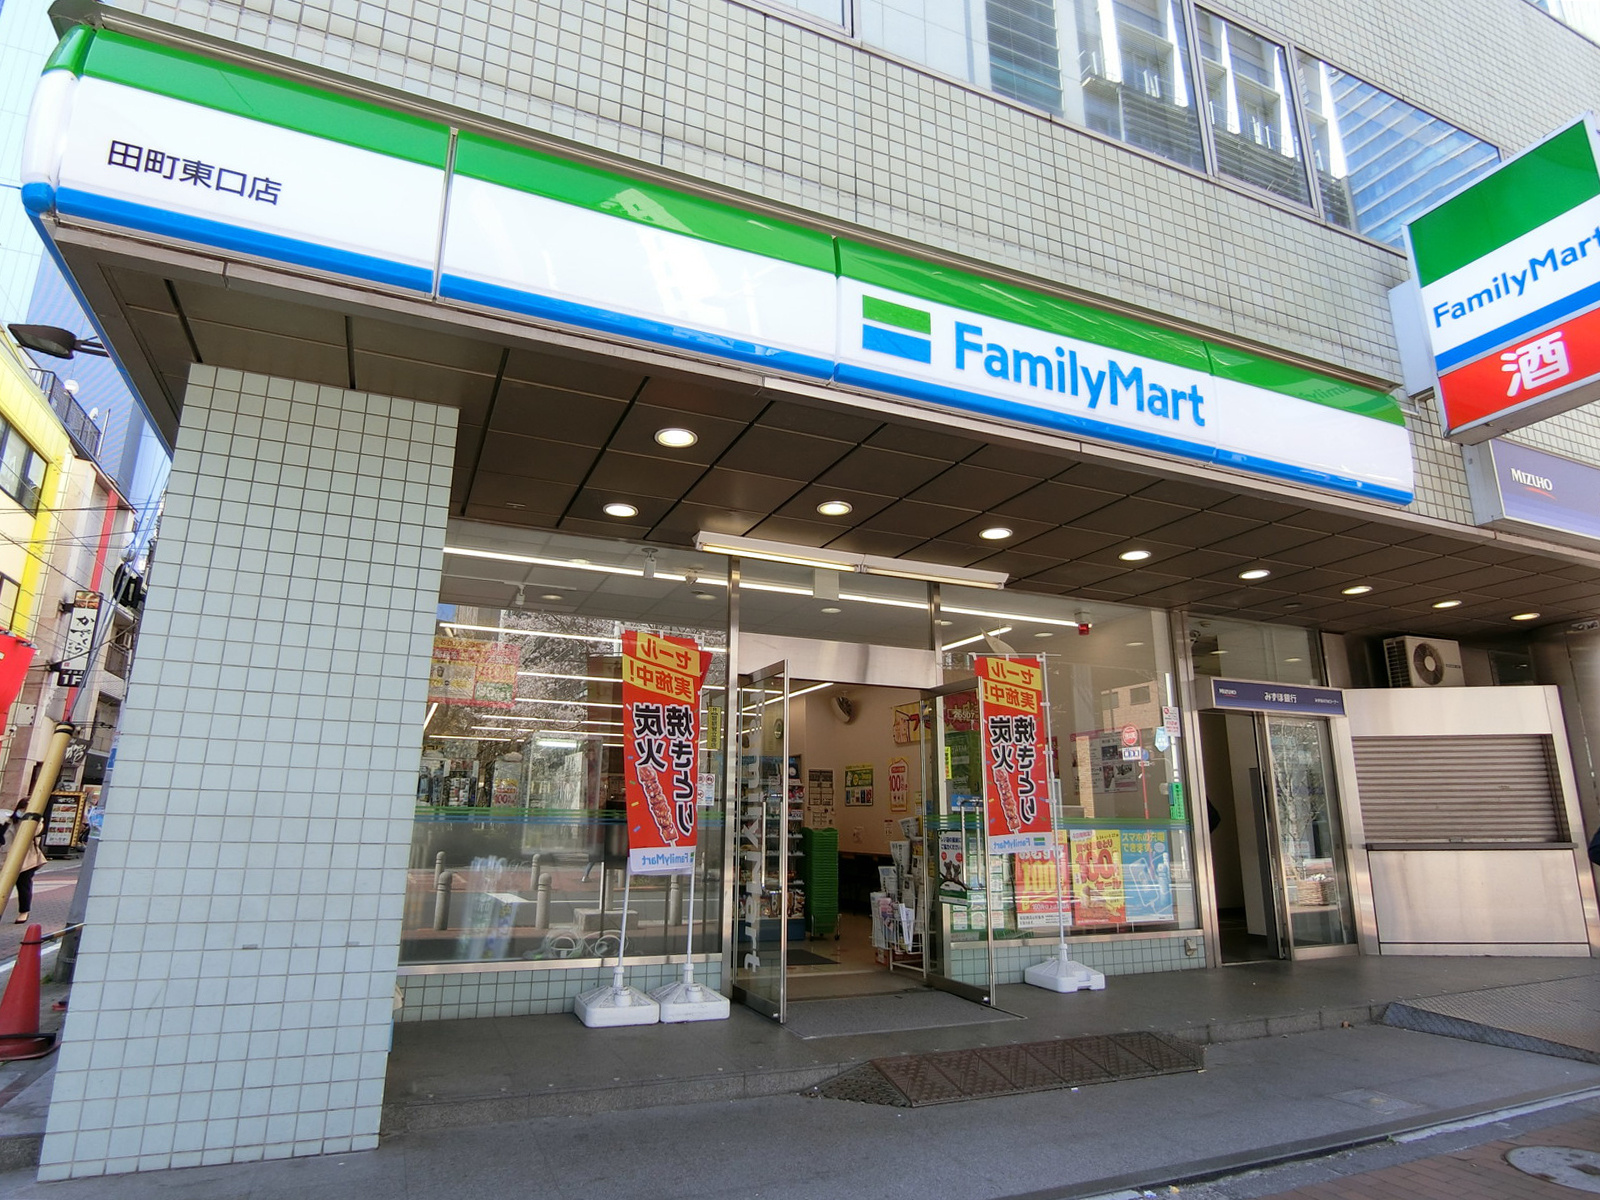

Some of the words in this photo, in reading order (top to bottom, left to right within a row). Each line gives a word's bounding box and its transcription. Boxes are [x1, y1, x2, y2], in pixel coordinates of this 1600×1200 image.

[107, 140, 282, 206] 田町東口店
[1433, 225, 1600, 329] FamilyMart
[955, 321, 1206, 427] FamilyMart
[1500, 331, 1572, 397] 酒
[1510, 467, 1553, 491] MIZUHO
